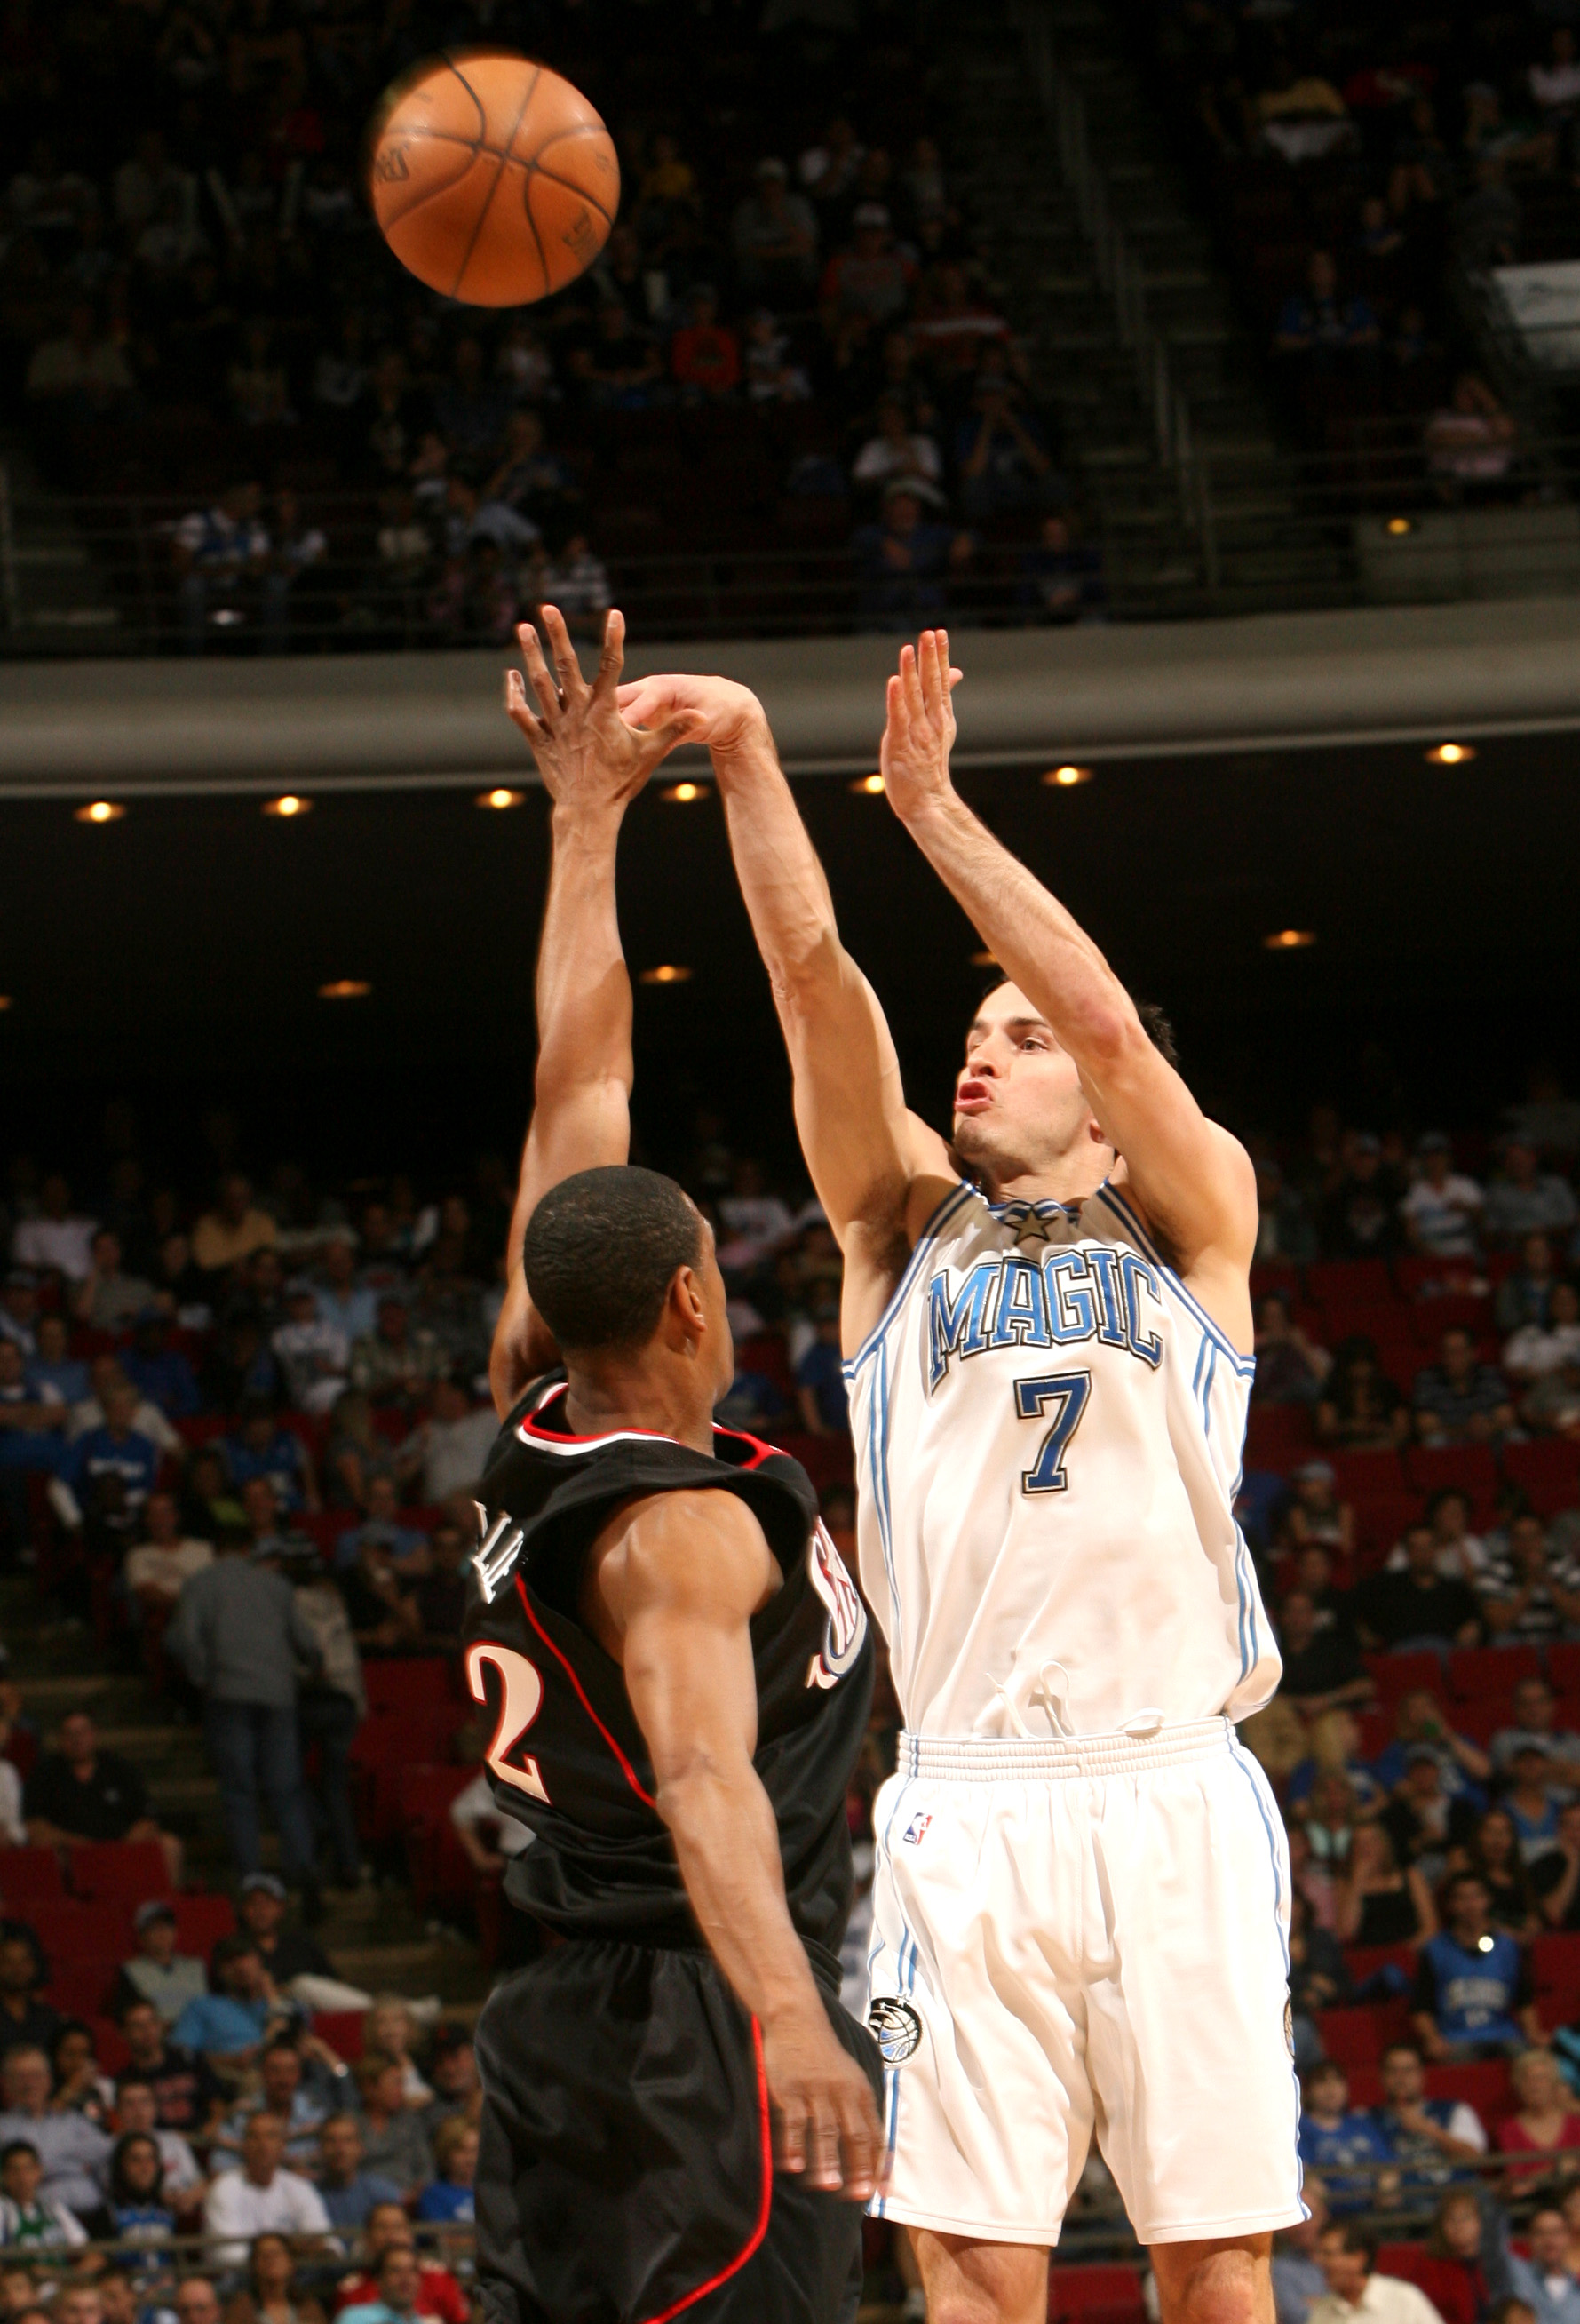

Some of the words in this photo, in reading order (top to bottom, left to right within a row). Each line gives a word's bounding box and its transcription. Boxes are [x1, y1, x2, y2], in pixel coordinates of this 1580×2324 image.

[928, 1248, 1164, 1396] MAGIC
[1012, 1369, 1093, 1494] 7
[464, 1640, 554, 1807] 2
